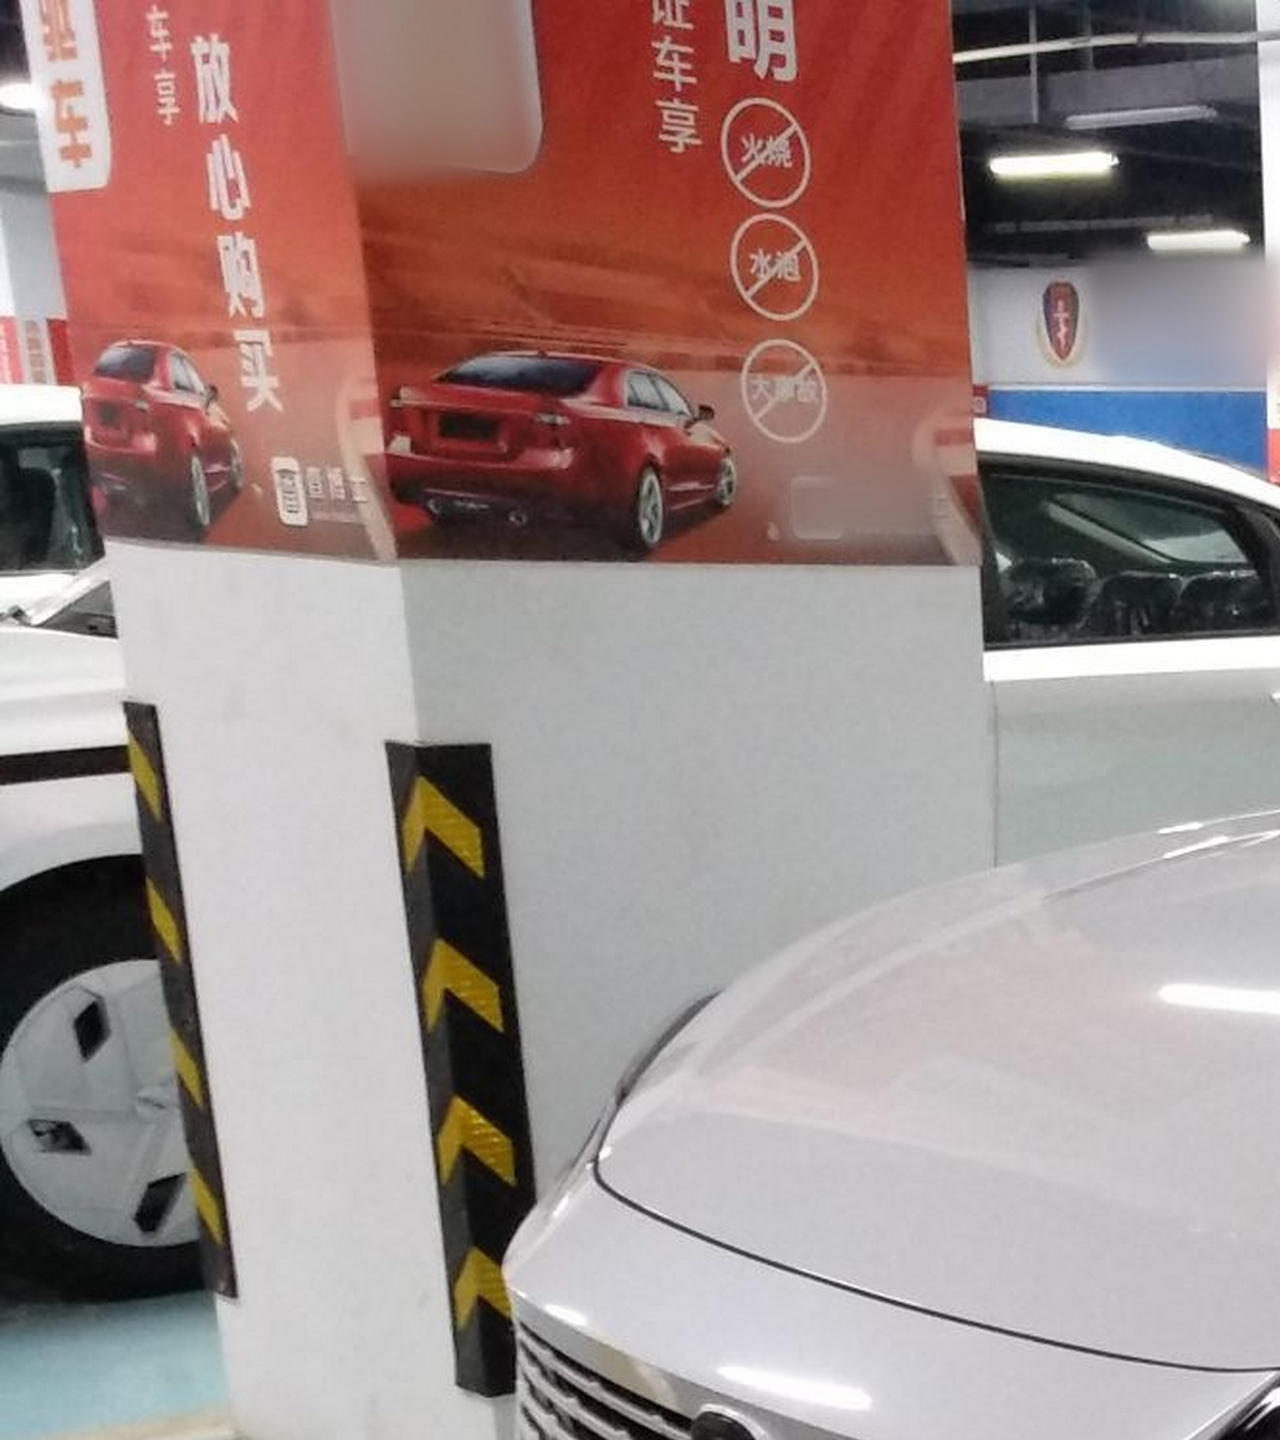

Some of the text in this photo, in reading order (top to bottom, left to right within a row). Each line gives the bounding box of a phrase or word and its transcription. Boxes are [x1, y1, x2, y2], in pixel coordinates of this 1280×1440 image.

[146, 4, 181, 126] 车享
[725, 0, 798, 82] 明
[190, 33, 284, 412] 放心购买
